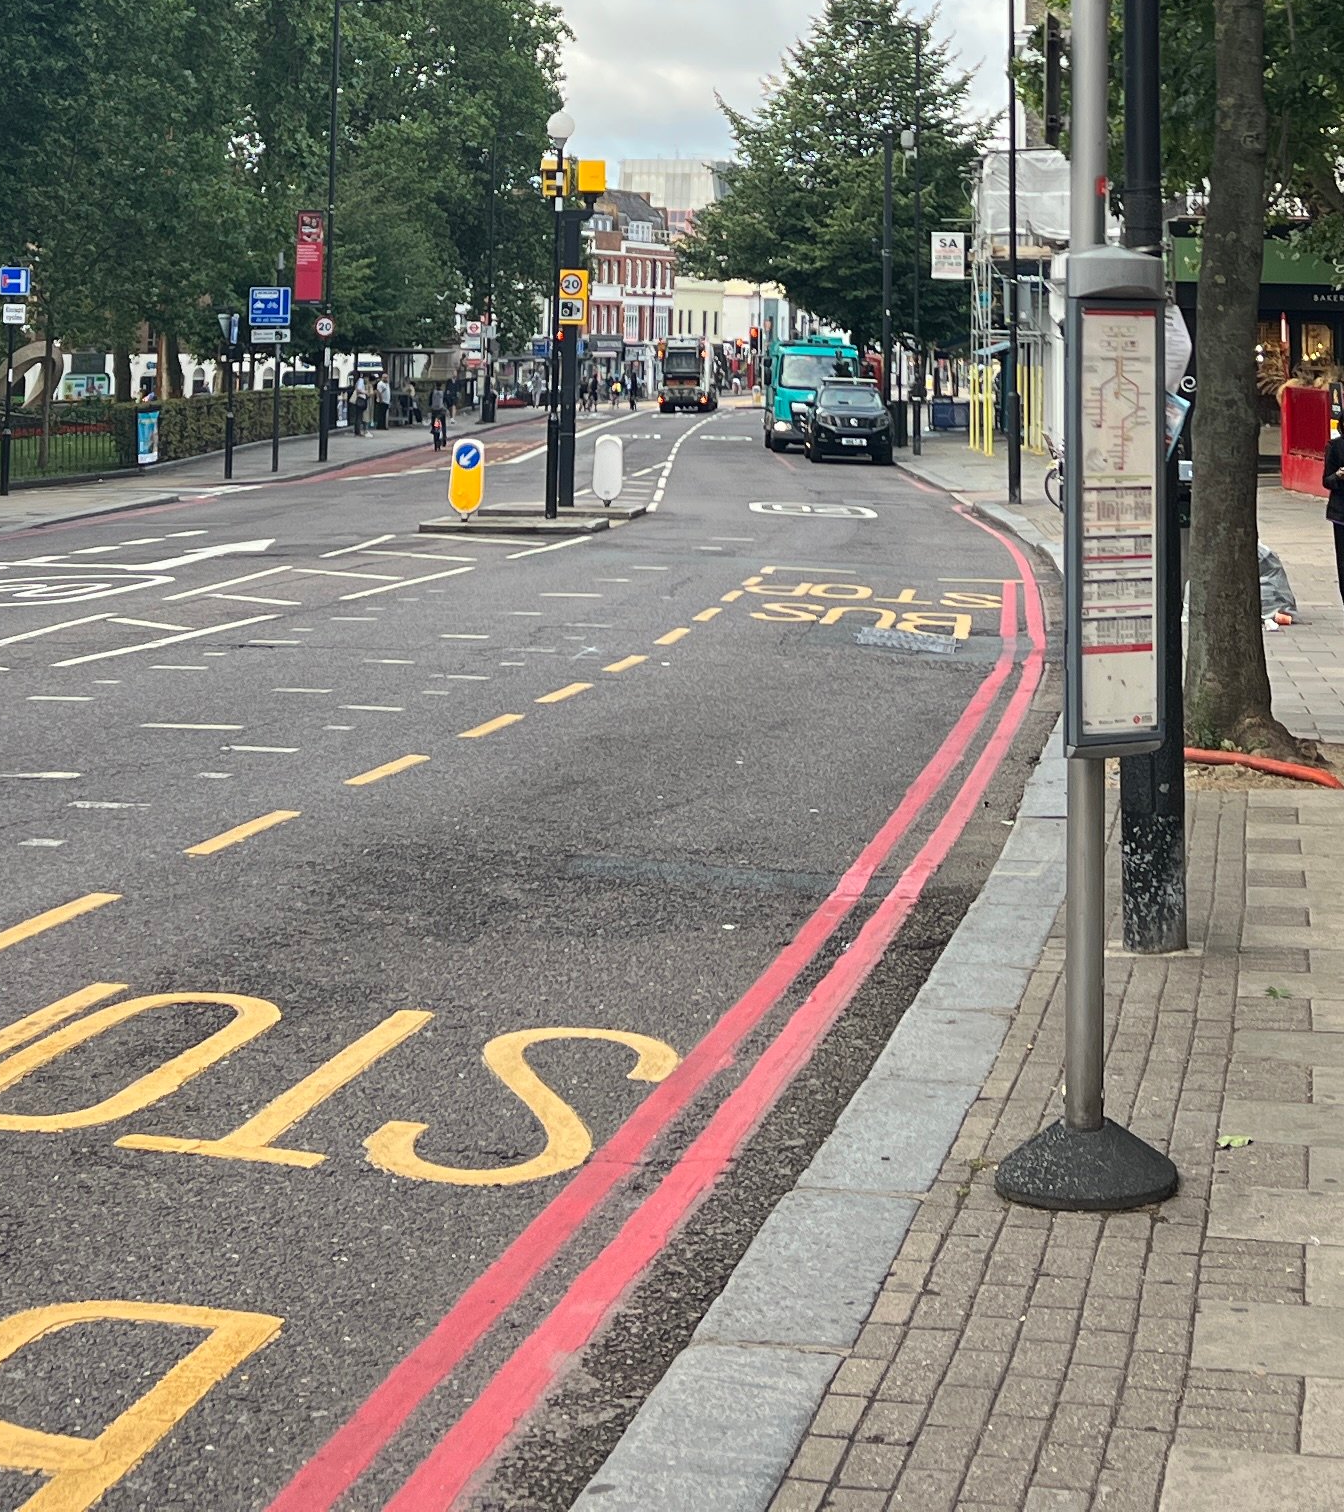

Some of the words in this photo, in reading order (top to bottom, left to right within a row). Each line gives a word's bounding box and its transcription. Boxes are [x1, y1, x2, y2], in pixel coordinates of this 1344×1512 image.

[563, 279, 579, 289] 20
[318, 322, 331, 332] 20
[745, 582, 1003, 609] STOP
[750, 602, 973, 640] BUS
